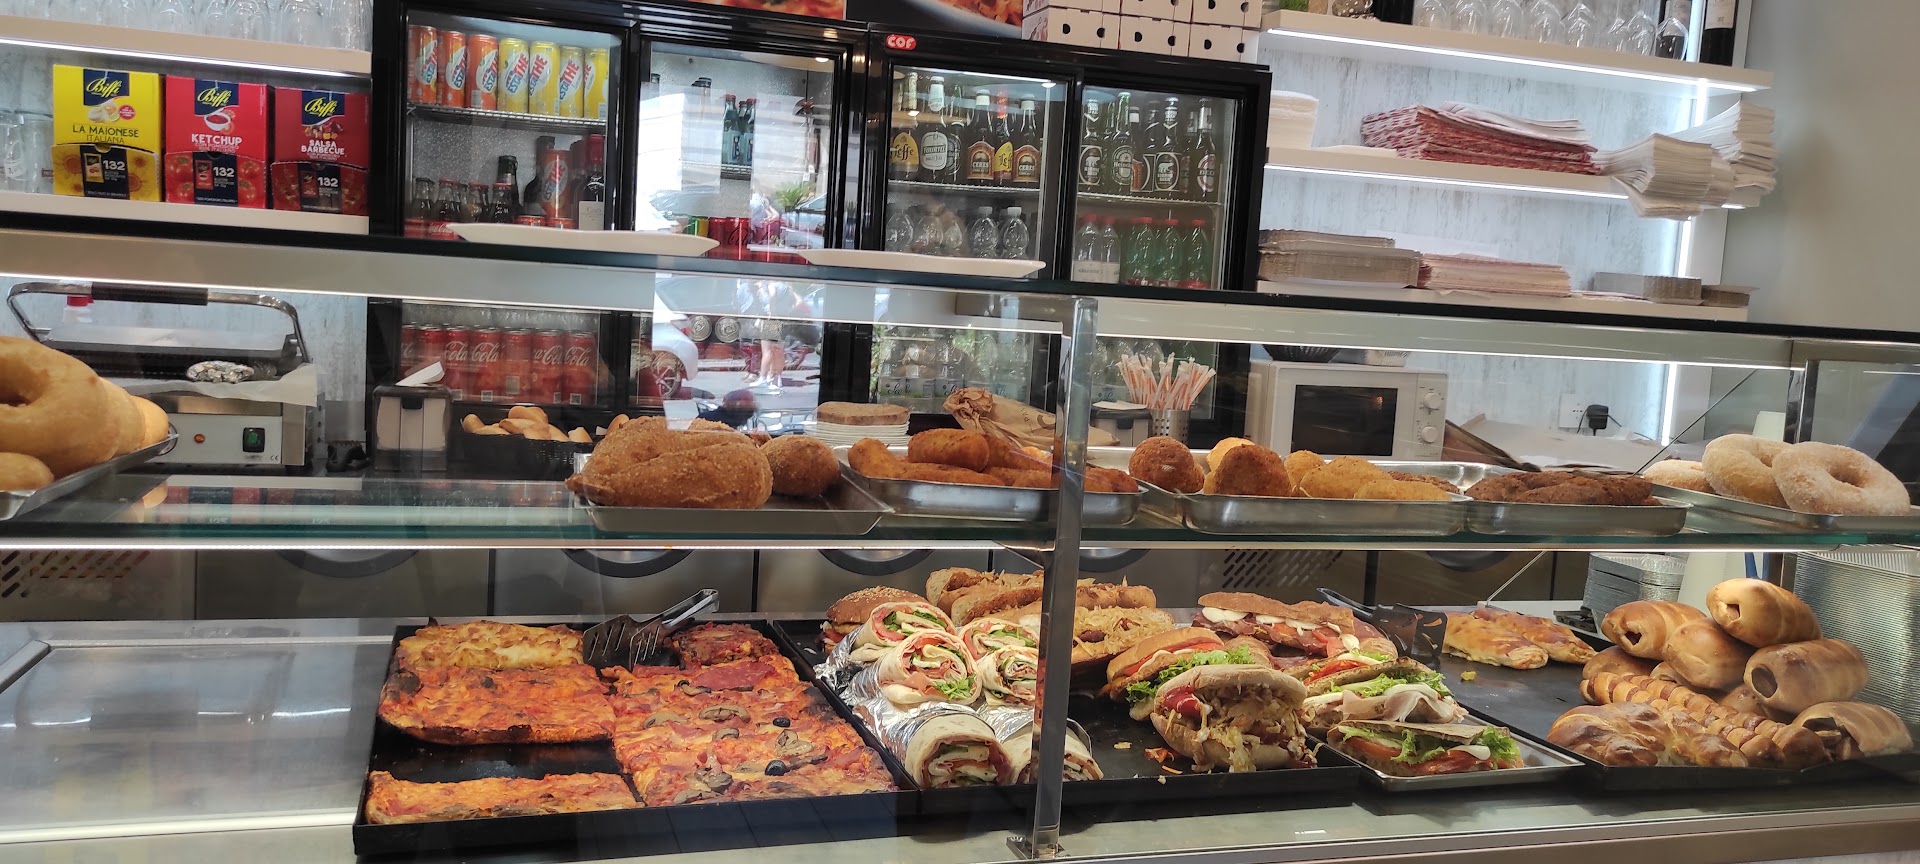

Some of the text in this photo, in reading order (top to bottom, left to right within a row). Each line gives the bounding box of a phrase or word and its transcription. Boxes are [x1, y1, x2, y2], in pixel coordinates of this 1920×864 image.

[86, 76, 122, 98] Biffi
[197, 87, 232, 107] Biffi
[304, 97, 337, 117] Biffi
[72, 124, 139, 138] LA MAIONESE
[86, 134, 125, 144] ITALIANA
[191, 133, 243, 146] KETCHUP
[309, 139, 337, 148] SALSA
[301, 145, 345, 155] BARBECUE
[102, 160, 126, 171] 132
[213, 166, 235, 178] 132
[317, 176, 339, 187] 132
